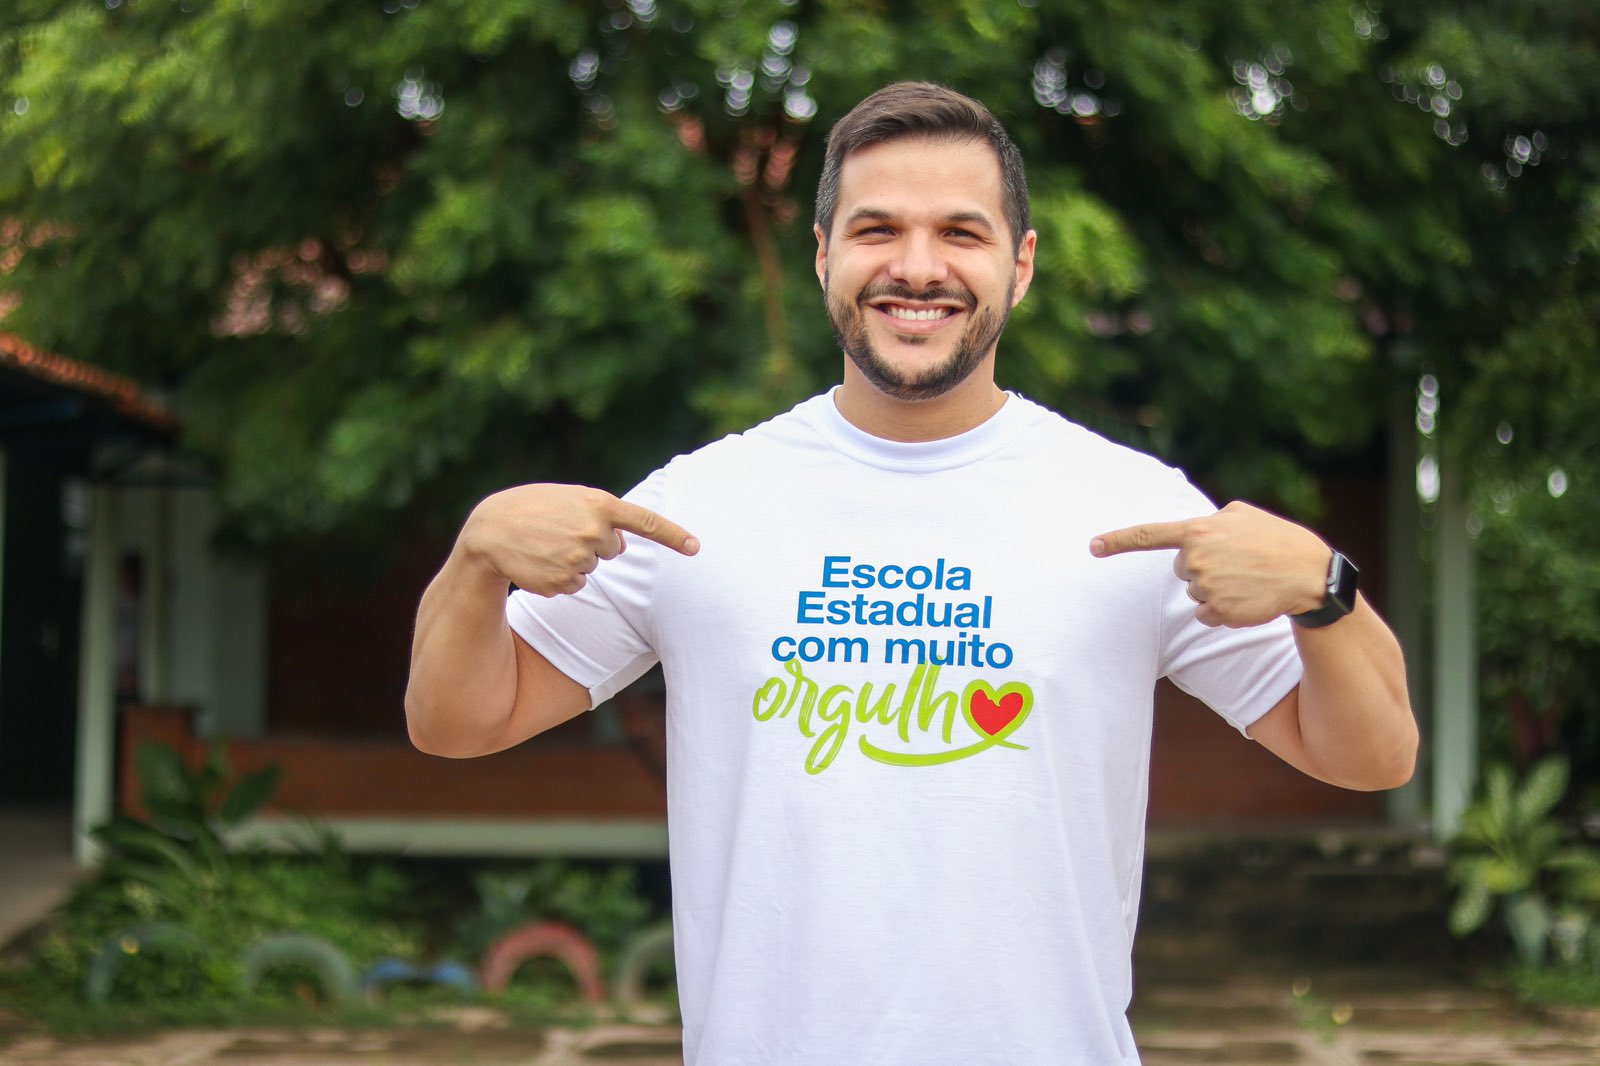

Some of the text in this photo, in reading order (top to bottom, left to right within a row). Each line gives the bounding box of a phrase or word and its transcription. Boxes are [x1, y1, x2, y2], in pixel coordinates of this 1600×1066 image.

[822, 555, 972, 591] Escola
[796, 591, 993, 629] Estadual
[771, 631, 1014, 669] com muito
